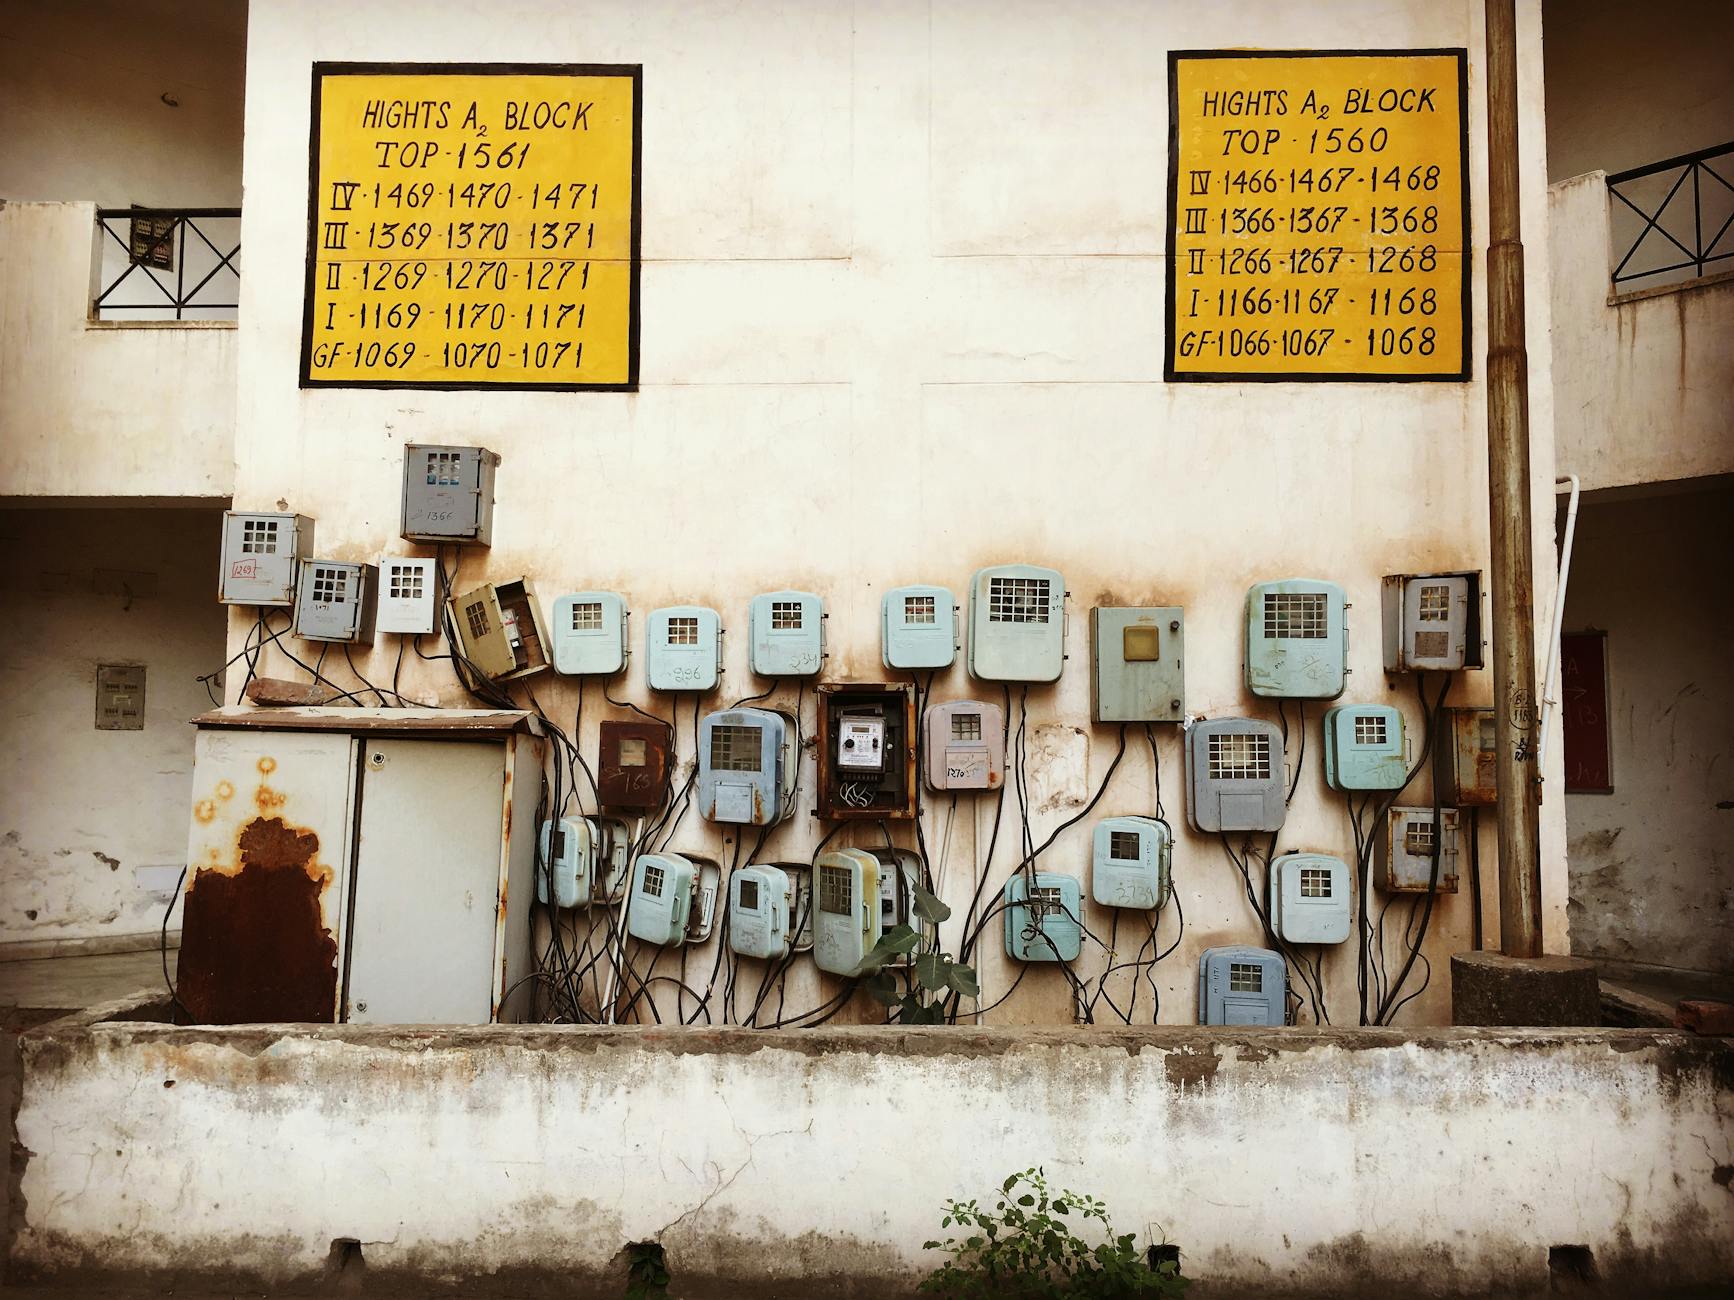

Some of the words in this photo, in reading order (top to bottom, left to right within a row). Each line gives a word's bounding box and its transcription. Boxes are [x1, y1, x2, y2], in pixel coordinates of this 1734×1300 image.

[363, 101, 450, 128] HIGHTS
[506, 102, 593, 130] BLOCK
[1204, 90, 1287, 116] HIGHTS
[1344, 89, 1436, 114] BLOCK
